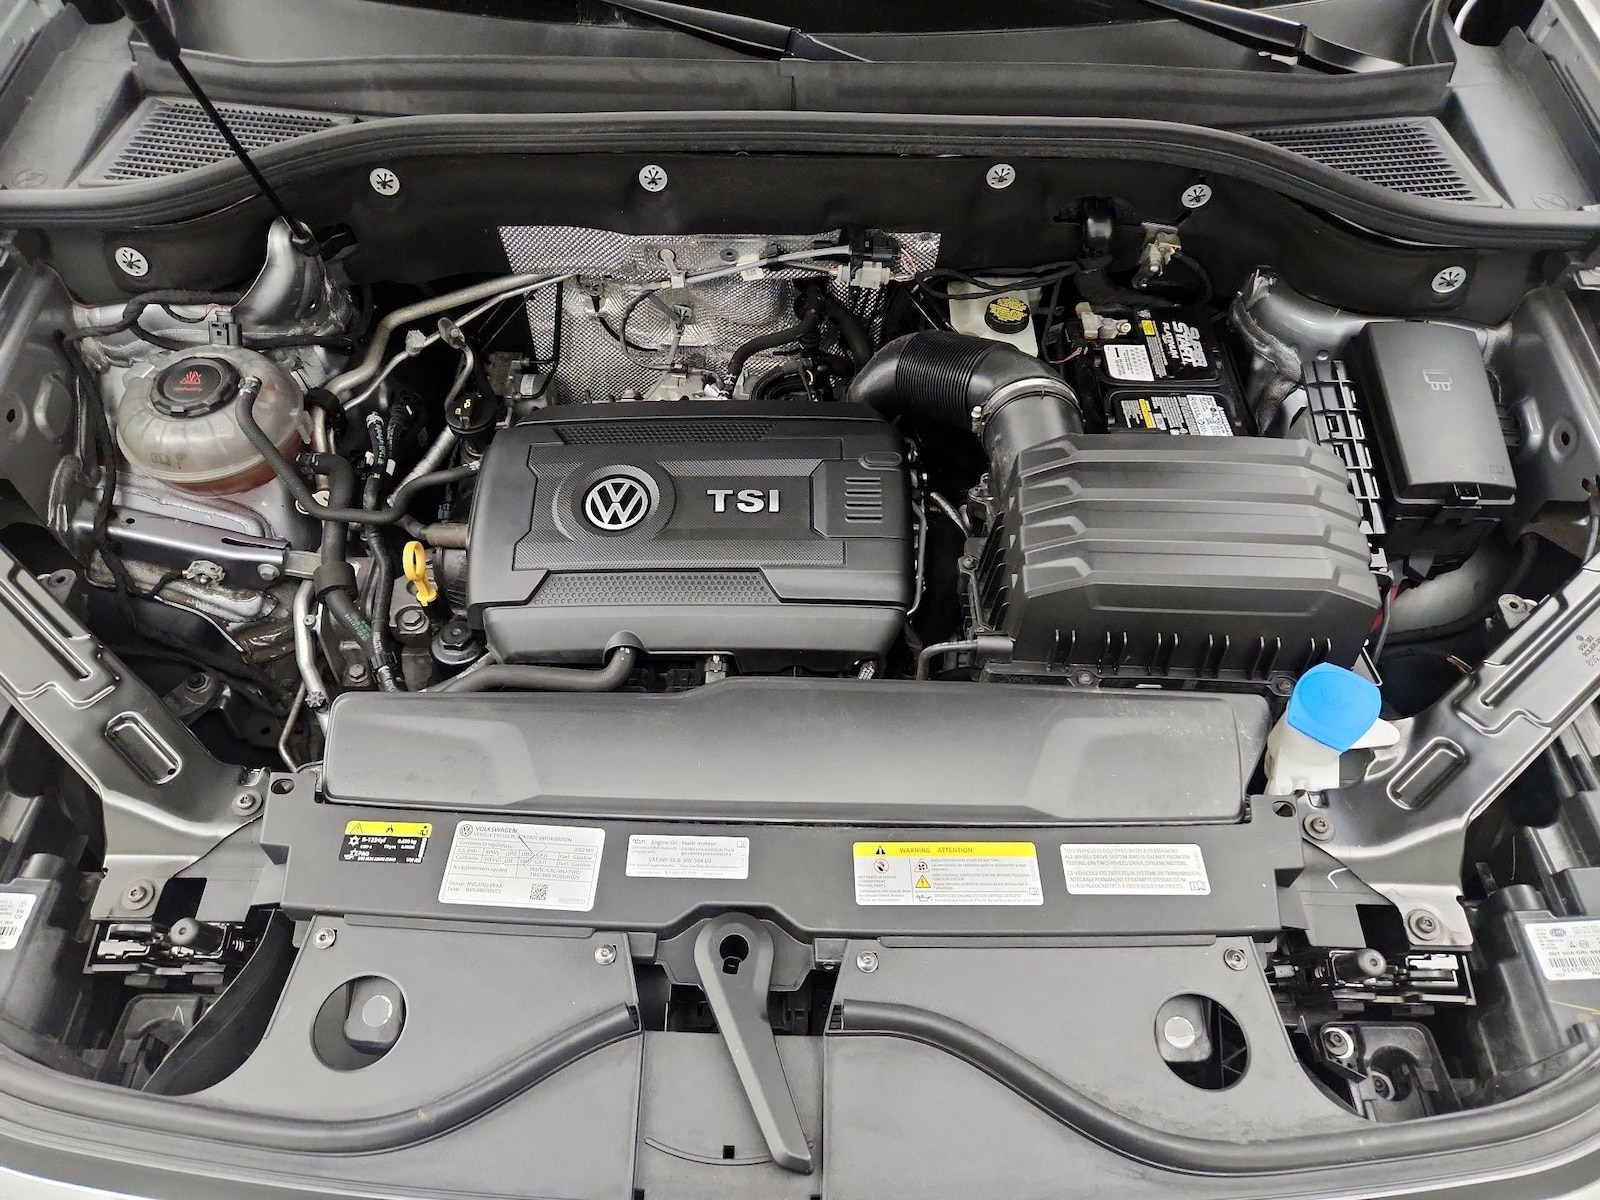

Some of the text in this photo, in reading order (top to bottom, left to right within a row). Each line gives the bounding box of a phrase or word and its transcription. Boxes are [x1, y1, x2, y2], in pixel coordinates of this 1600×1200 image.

[1162, 322, 1179, 359] PLATINUM
[1172, 321, 1193, 366] START
[1189, 327, 1208, 367] SUPER
[707, 490, 780, 513] TSI
[476, 826, 518, 834] VOLKSWAGEN
